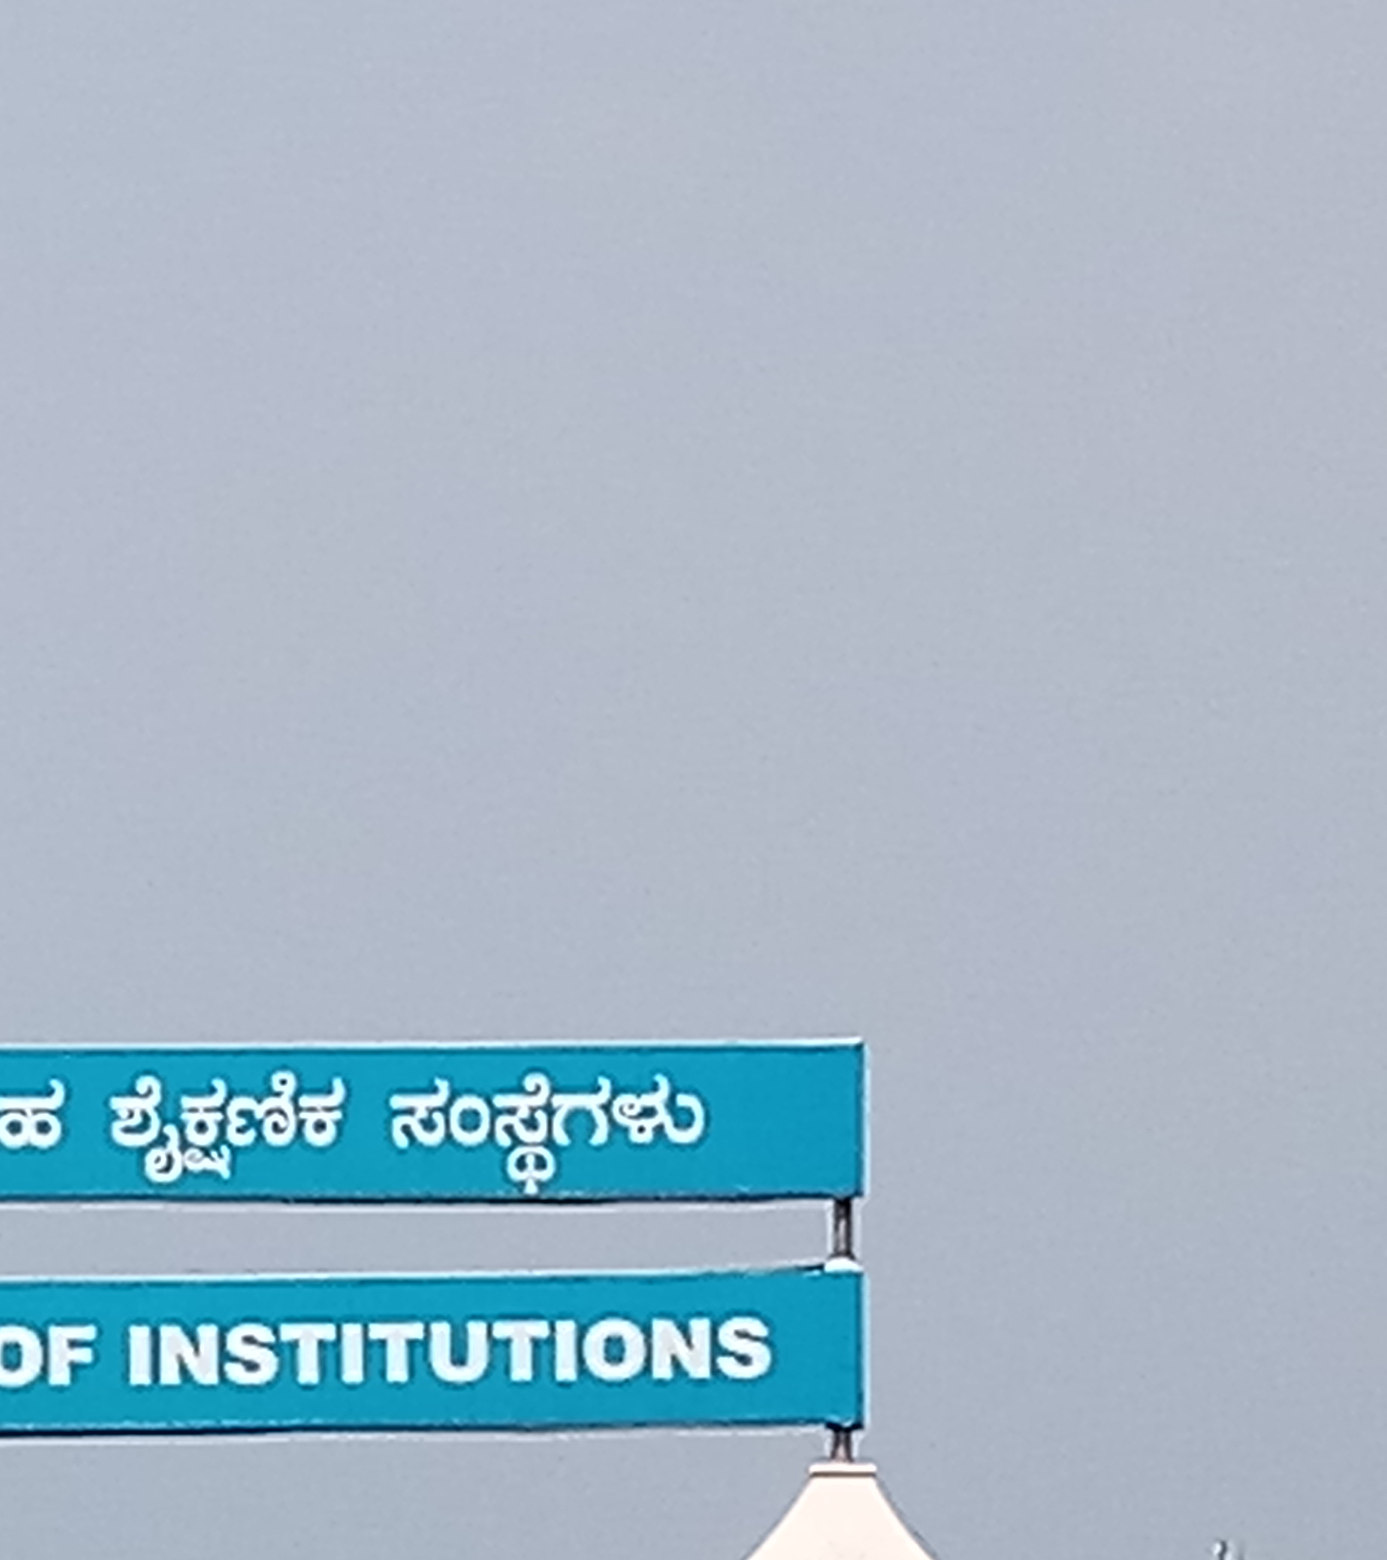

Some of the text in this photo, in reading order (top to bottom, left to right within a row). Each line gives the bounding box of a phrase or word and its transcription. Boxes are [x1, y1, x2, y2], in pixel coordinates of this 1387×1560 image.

[109, 1070, 346, 1184] ಶೈಕ್ಷಣಿಕ
[389, 1072, 705, 1197] ಸಂಸ್ಥೆಗಳು
[128, 1316, 772, 1386] INSTITUTIONS
